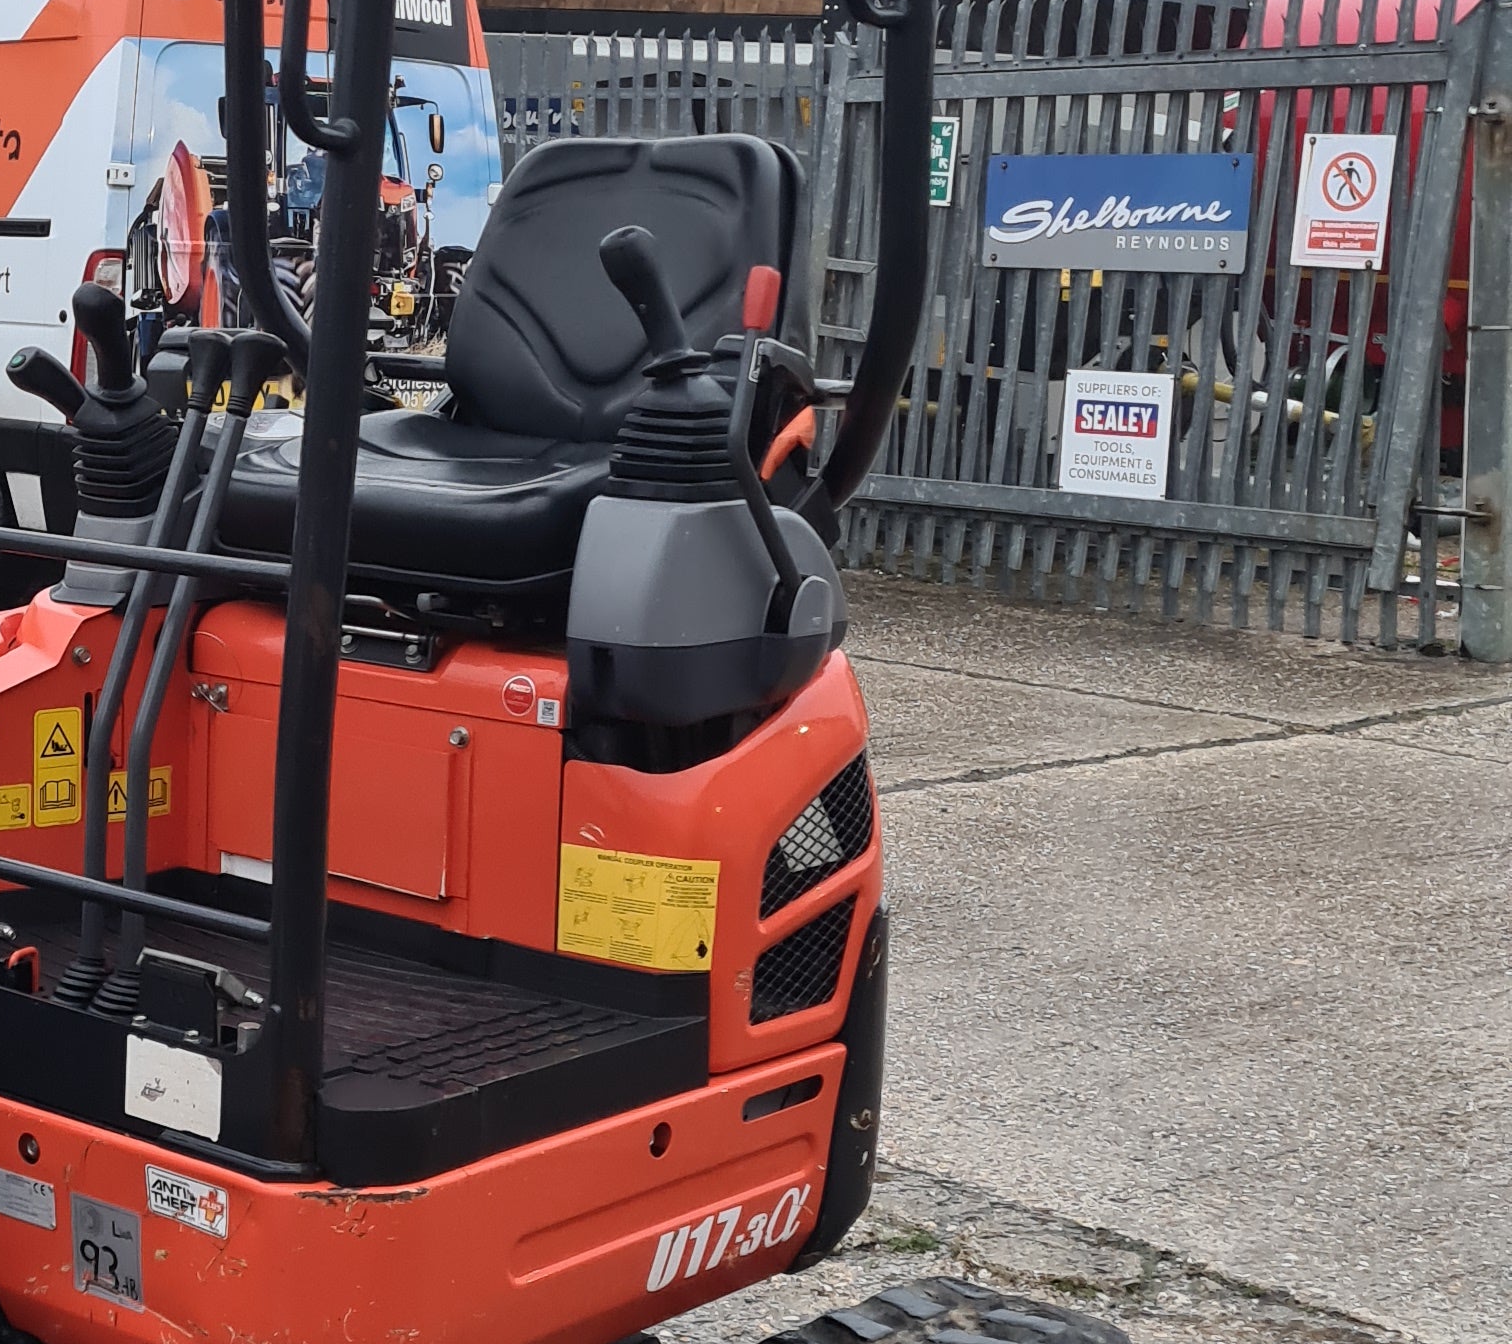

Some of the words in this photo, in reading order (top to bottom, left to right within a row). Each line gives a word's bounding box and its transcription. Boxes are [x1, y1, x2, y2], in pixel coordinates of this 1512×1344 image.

[989, 195, 1232, 244] Shelbourne
[1115, 235, 1231, 251] REYNOLDS
[1076, 382, 1138, 397] SUPPLIERS
[1141, 386, 1161, 397] OF:
[1080, 403, 1153, 434] SEALEY
[1093, 441, 1135, 455] TOOLS,
[1074, 453, 1142, 469] EQUIPMENT
[1145, 459, 1153, 470] &
[1068, 467, 1157, 485] CONSUMABLES
[624, 857, 654, 867] COUPLER
[655, 860, 693, 871] OPERATION
[675, 874, 715, 884] CAUTION
[33, 1182, 46, 1197] CE
[151, 1178, 187, 1200] ANTI
[151, 1189, 197, 1216] THEFT
[79, 1239, 120, 1291] 93
